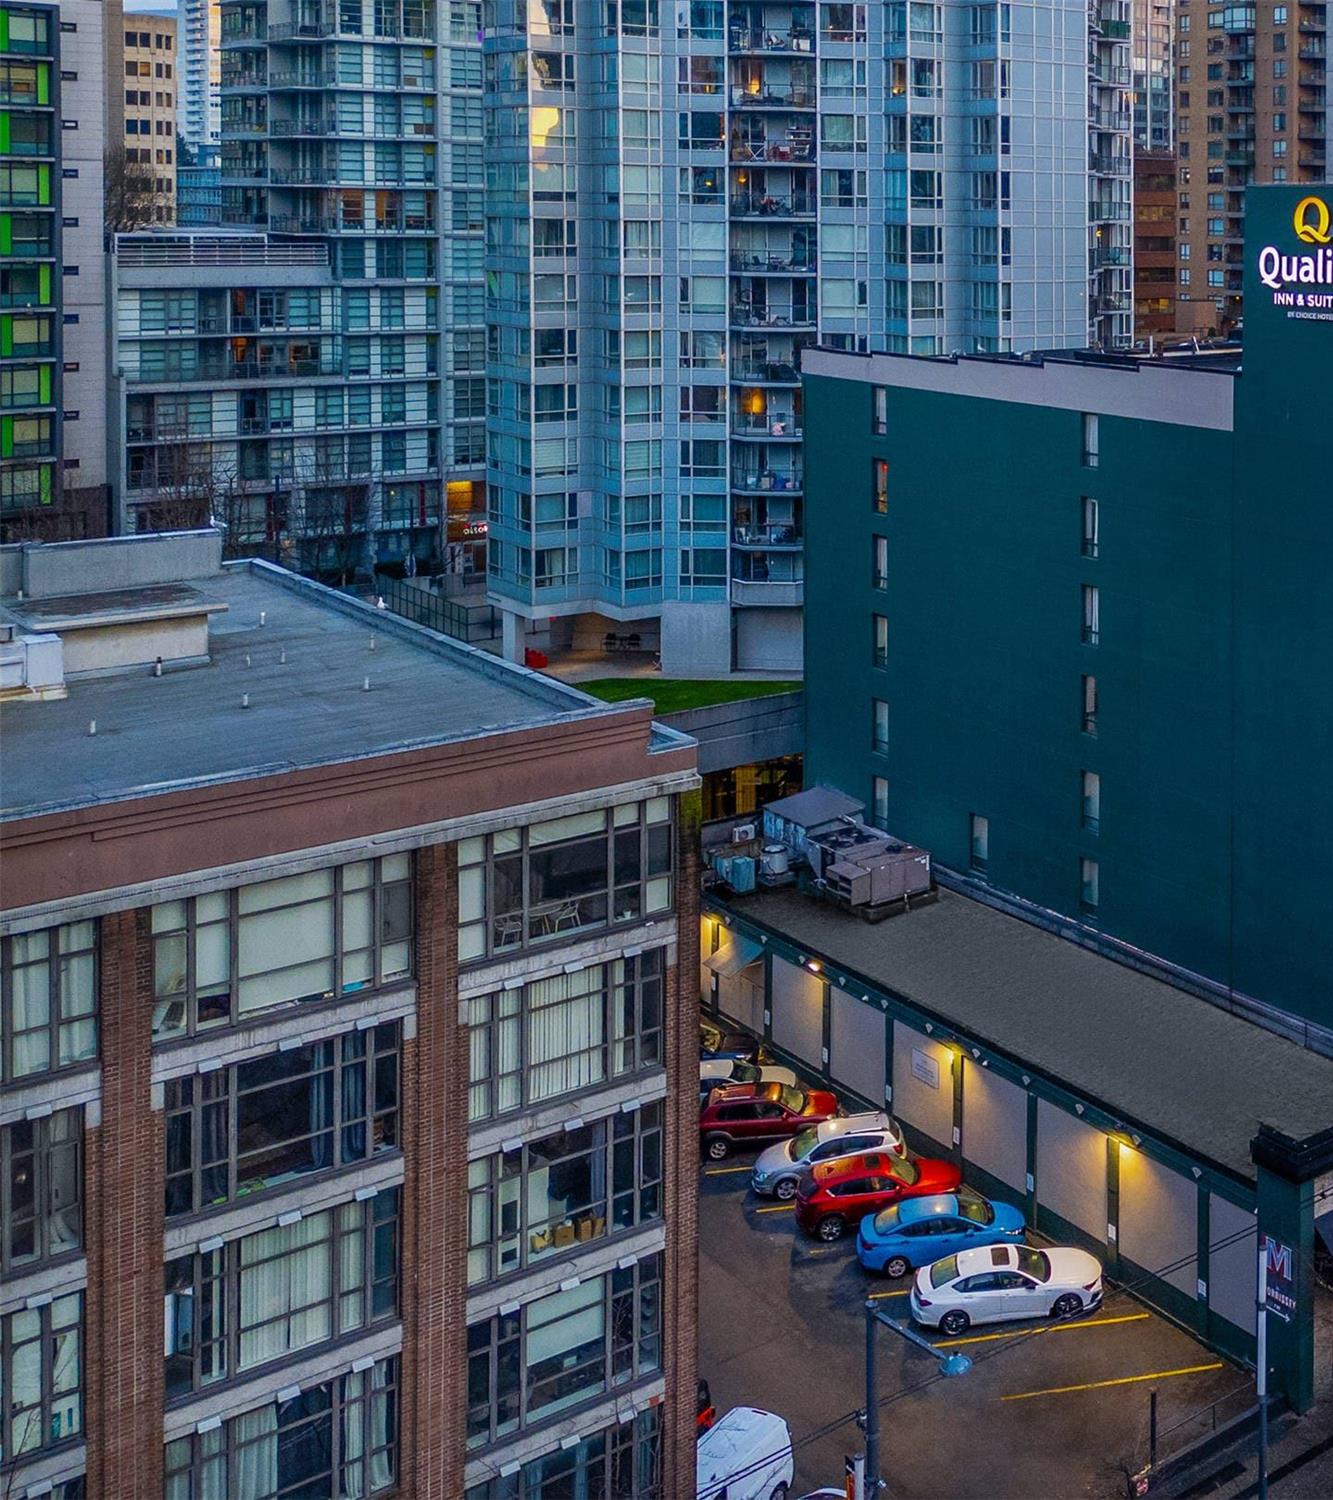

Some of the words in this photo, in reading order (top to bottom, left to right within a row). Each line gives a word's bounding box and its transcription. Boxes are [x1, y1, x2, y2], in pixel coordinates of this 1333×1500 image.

[1294, 196, 1332, 243] Q
[1273, 292, 1294, 306] INN
[1296, 294, 1305, 306] &
[1295, 311, 1317, 319] CHOICE
[1266, 1286, 1297, 1309] ORRISSEY
